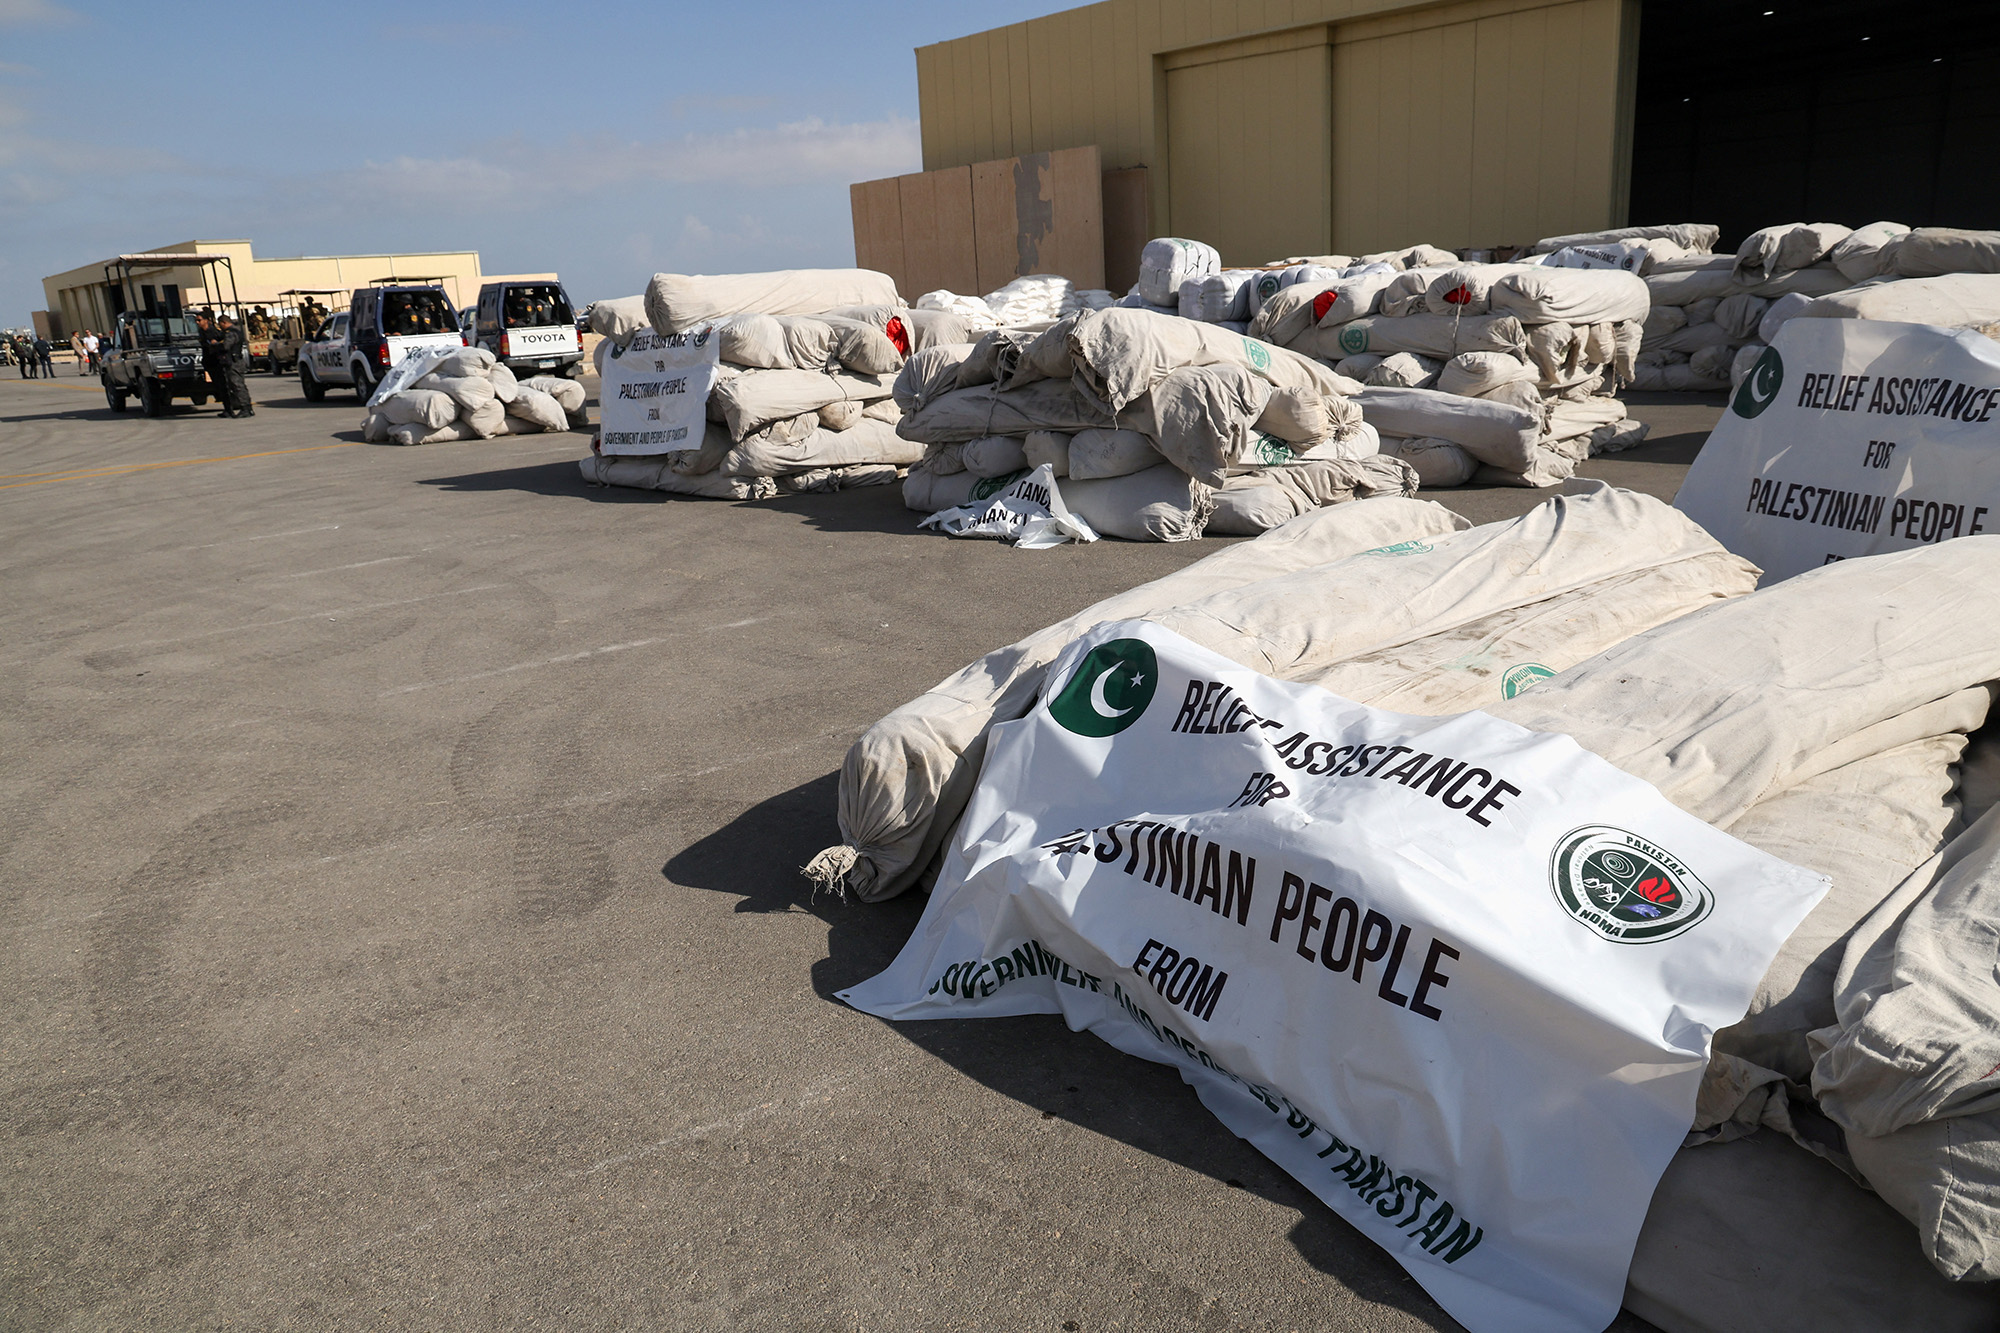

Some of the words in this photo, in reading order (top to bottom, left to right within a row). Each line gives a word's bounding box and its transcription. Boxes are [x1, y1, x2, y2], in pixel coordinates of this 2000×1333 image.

[520, 333, 566, 344] TOYOTA
[172, 355, 203, 366] TOY
[317, 351, 343, 367] POLICE
[661, 377, 687, 396] PEOPLE
[1798, 372, 1869, 412] RELIEF
[1867, 376, 2000, 423] ASSISTANCE
[1863, 440, 1896, 470] FOR
[1747, 477, 1886, 535] PALESTINIAN
[1890, 498, 1988, 543] PEOPLE
[1228, 771, 1291, 809] FOR
[1264, 731, 1522, 828] ASSISTANCE
[1626, 835, 1688, 877] PAKISTAN
[1578, 909, 1622, 937] NDMA
[1270, 869, 1461, 1022] PEOPLE
[1132, 938, 1229, 1023] FROM
